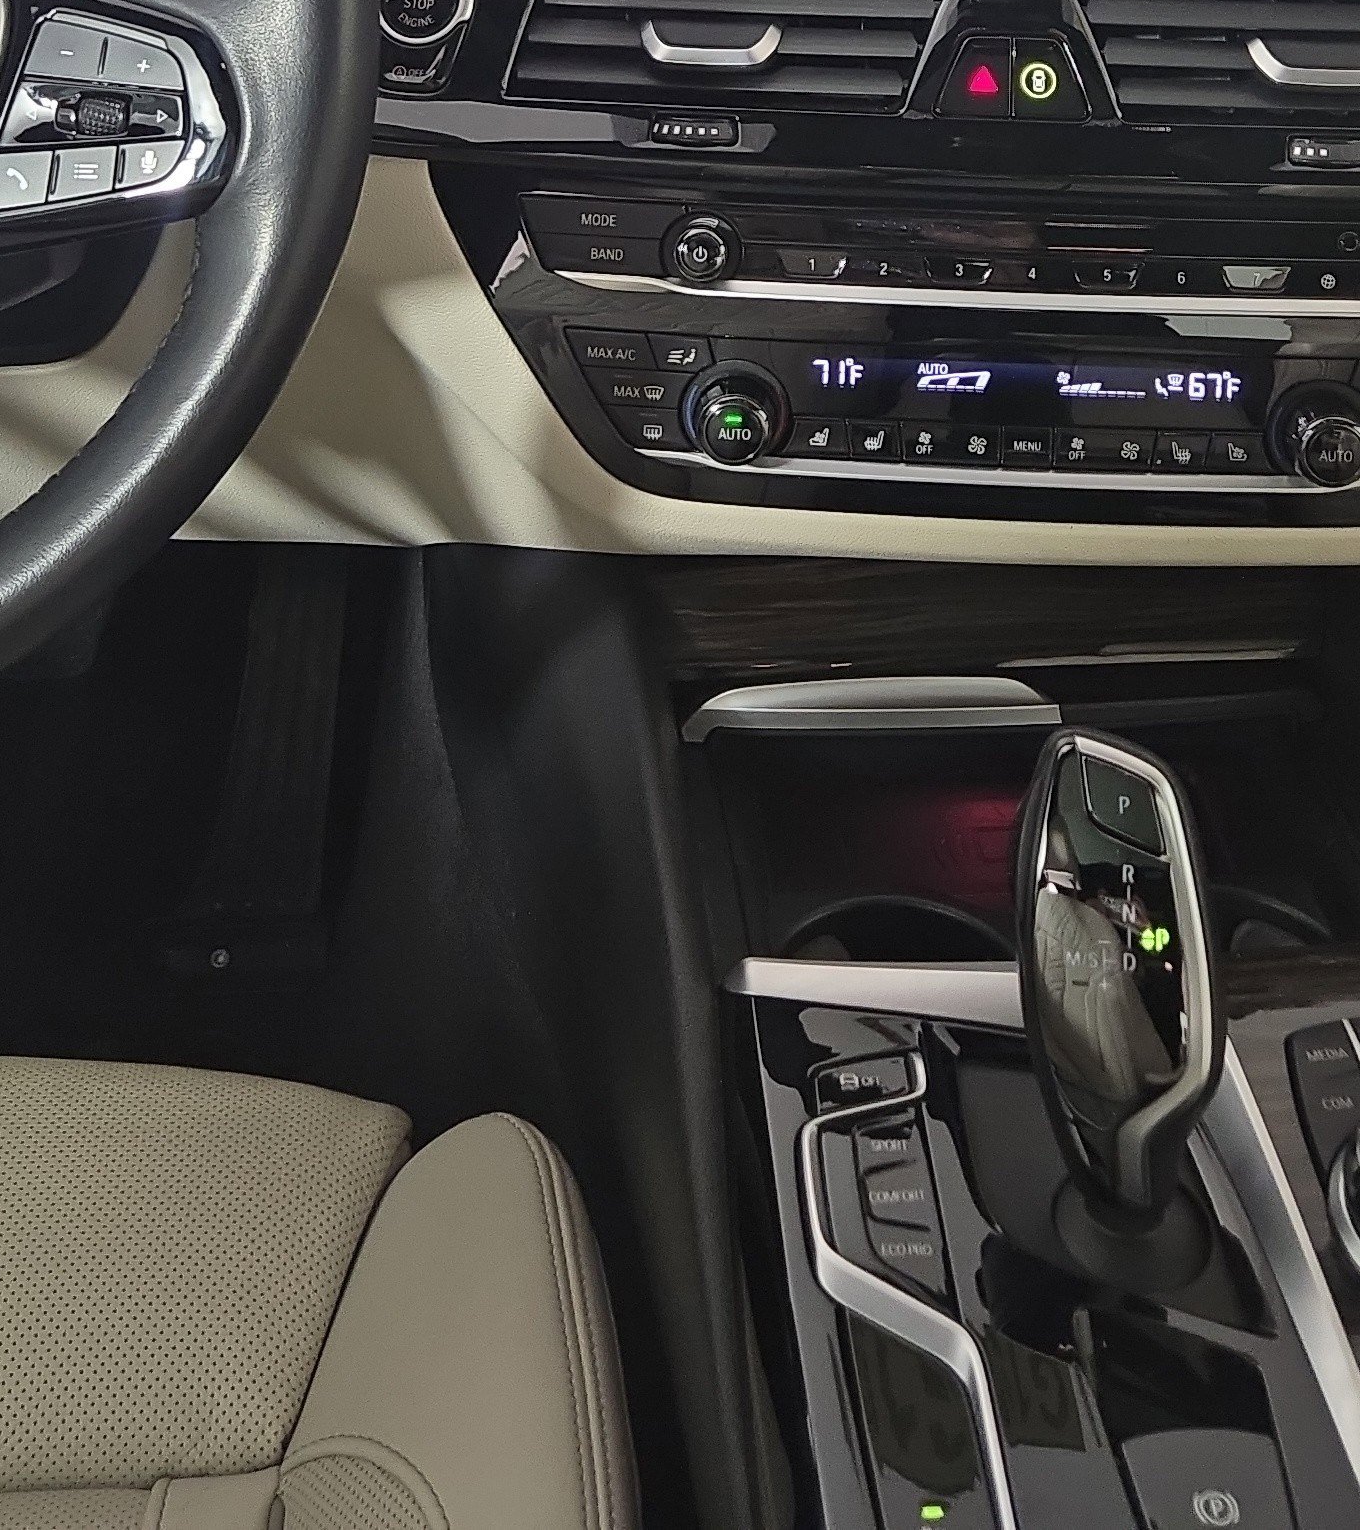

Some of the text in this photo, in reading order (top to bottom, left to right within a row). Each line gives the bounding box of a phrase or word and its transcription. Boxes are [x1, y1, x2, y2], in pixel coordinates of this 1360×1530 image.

[397, 12, 436, 28] ENGINE
[580, 213, 617, 228] MODE
[590, 247, 624, 262] BAND
[807, 258, 816, 272] 1
[879, 262, 889, 276] 2
[955, 263, 964, 277] 3
[1028, 267, 1037, 280] 4
[1103, 269, 1112, 282] 5
[1177, 271, 1186, 285] 6
[587, 346, 637, 361] MAX A/C
[917, 362, 949, 375] AUTO
[613, 385, 641, 399] MAX
[717, 427, 753, 441] AUTO
[915, 444, 934, 455] OFF
[1013, 440, 1042, 452] MENU
[1068, 450, 1086, 461] OFF
[1318, 449, 1354, 463] AUTO
[1118, 795, 1131, 815] P
[1122, 863, 1135, 884] R
[1121, 902, 1137, 923] N
[1122, 951, 1137, 971] D
